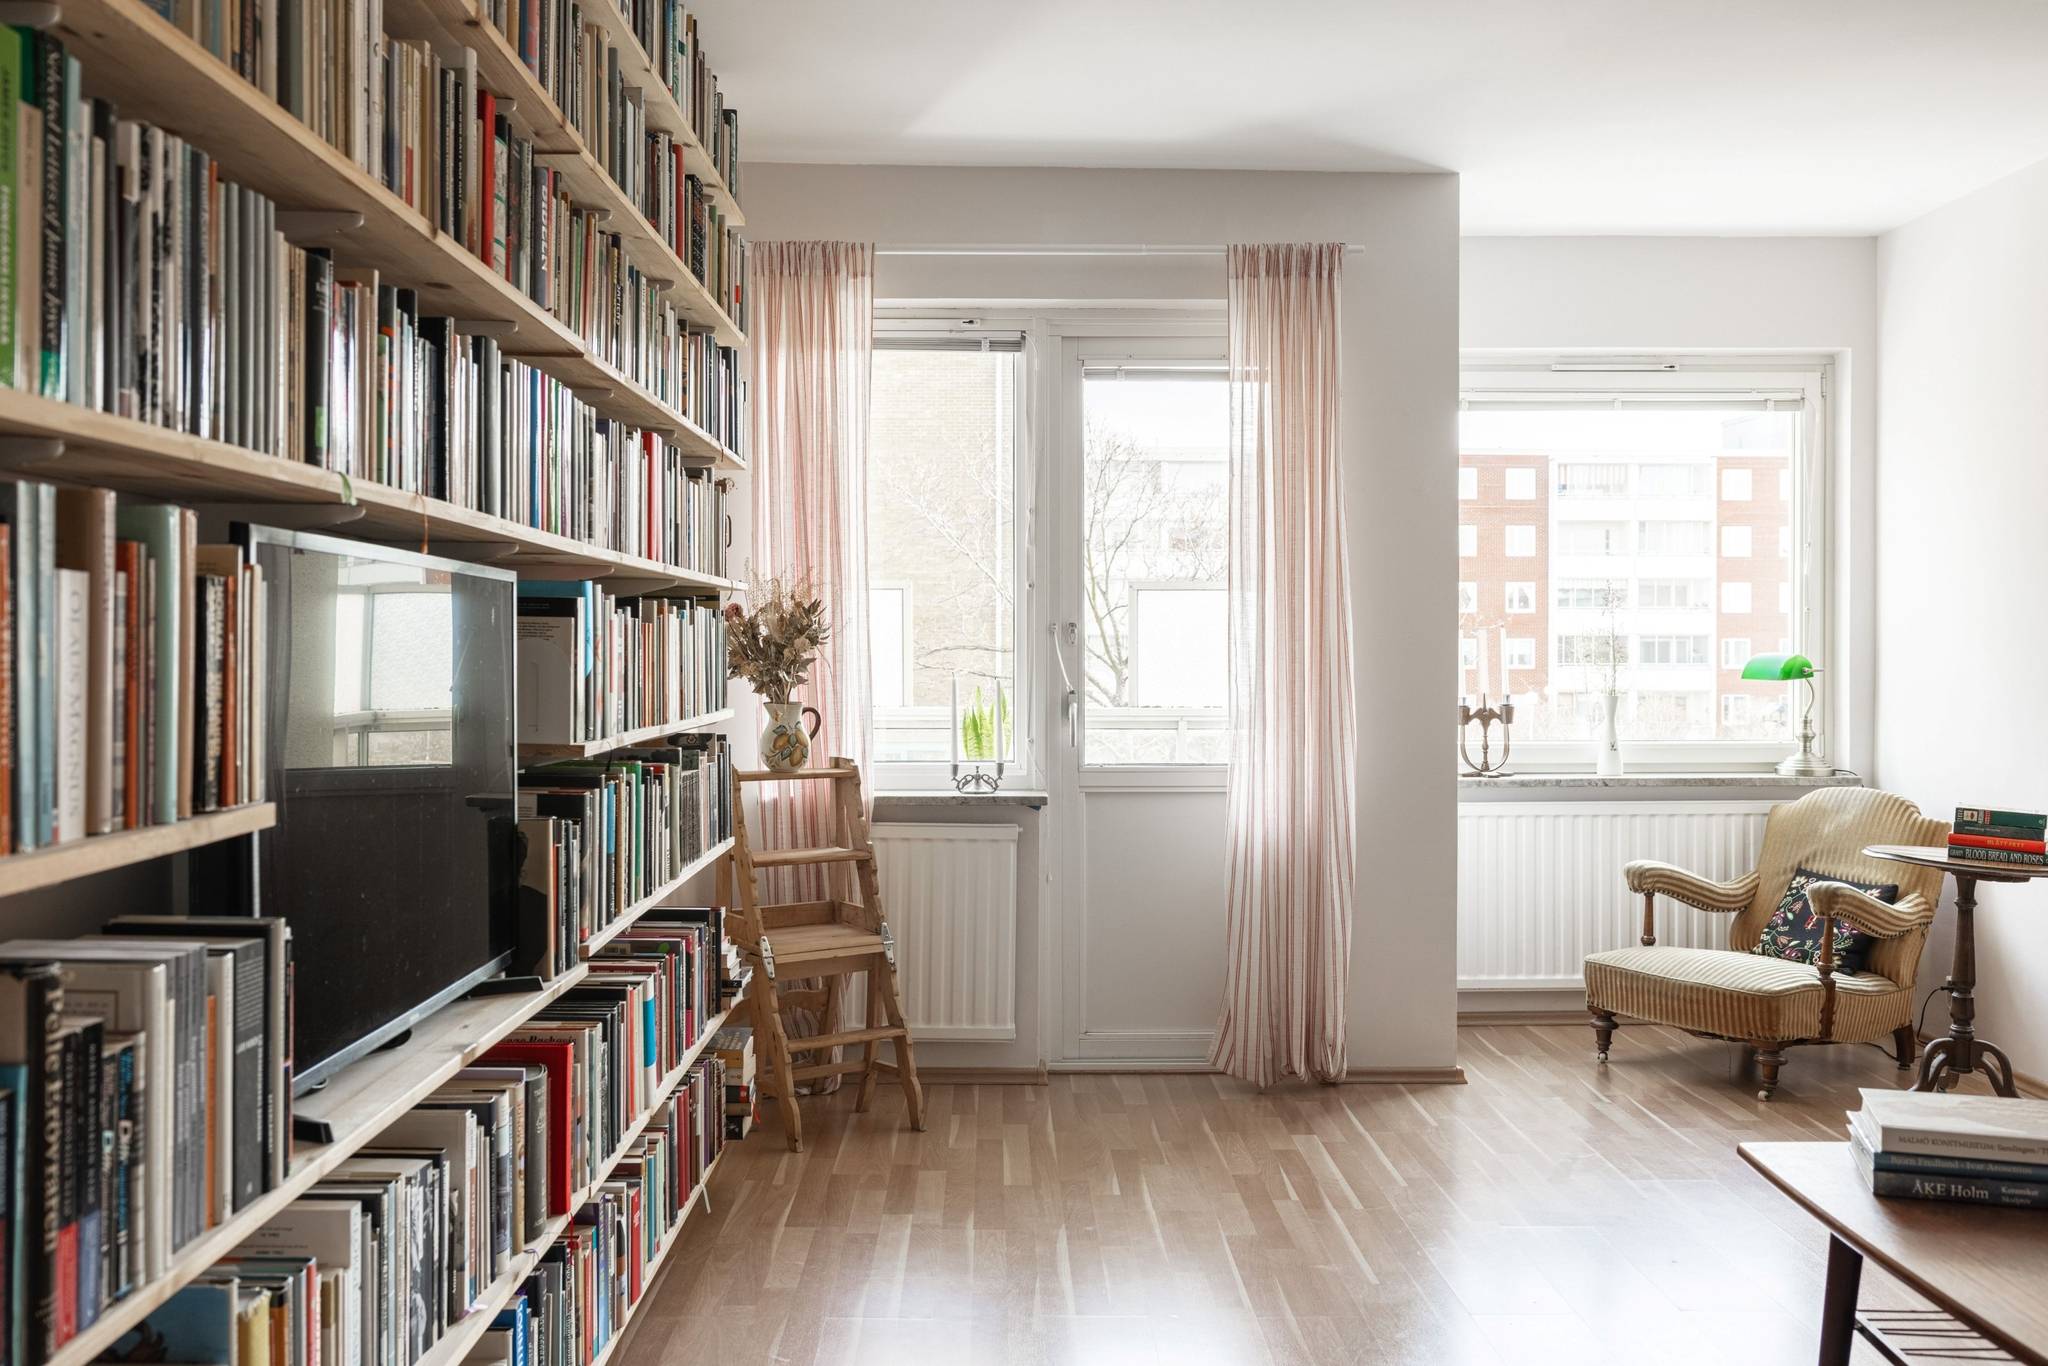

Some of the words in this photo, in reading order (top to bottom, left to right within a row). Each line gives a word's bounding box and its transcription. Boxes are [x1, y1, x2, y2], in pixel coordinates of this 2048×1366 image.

[46, 134, 62, 201] Letters
[44, 229, 62, 289] James
[44, 291, 62, 346] Joyce
[69, 590, 84, 683] OLAUS
[68, 694, 82, 817] MAGNUS
[2009, 853, 2022, 863] AND
[2024, 854, 2044, 865] ROSES
[45, 987, 64, 1073] Pelle
[43, 1079, 62, 1254] Erövraren
[1898, 1135, 1930, 1145] MALMÖ
[1912, 1178, 1946, 1196] ÅKE
[1950, 1184, 1990, 1200] Holm
